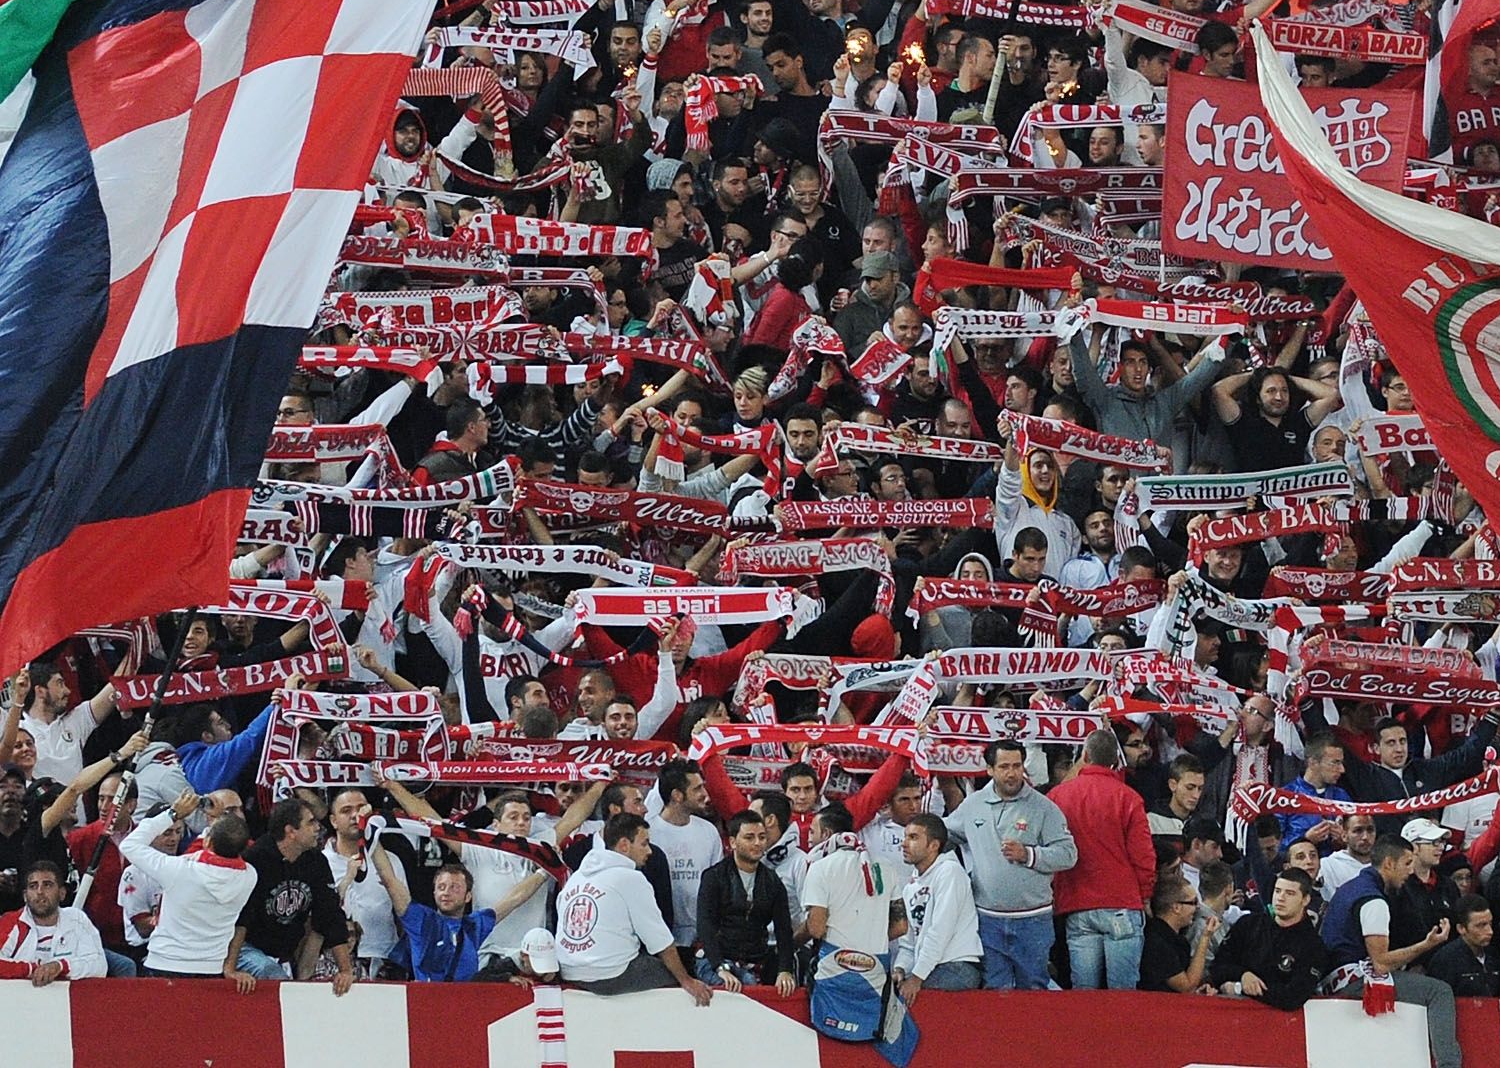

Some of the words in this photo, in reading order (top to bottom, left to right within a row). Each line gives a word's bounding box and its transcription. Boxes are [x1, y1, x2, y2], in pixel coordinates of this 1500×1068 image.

[1145, 18, 1164, 34] as
[1274, 22, 1345, 49] FORZA
[1370, 32, 1424, 56] BARI
[431, 292, 496, 323] Bari
[1142, 304, 1169, 321] as
[1174, 304, 1218, 325] bari
[478, 330, 524, 354] BARI
[611, 334, 693, 363] BARI
[1149, 480, 1247, 502] Stampo
[1255, 470, 1349, 493] Italiano
[803, 501, 871, 514] PASSIONE
[878, 502, 888, 513] E
[890, 500, 967, 515] ORGOGLIO
[827, 515, 842, 527] AL
[847, 515, 873, 527] TUO
[642, 597, 672, 614] as
[676, 594, 721, 613] bari
[480, 653, 530, 678] BARI
[939, 652, 1001, 677] BARI
[1005, 651, 1082, 675] SIAMO
[1328, 640, 1401, 663] FORZA
[1406, 646, 1468, 671] BARI
[126, 670, 212, 700] U.C.N.
[245, 649, 323, 687] BARI
[1304, 669, 1353, 690] Del
[1359, 672, 1417, 696] Bari
[442, 766, 473, 774] NON
[475, 765, 538, 774] MOLLATE
[540, 766, 567, 774] MAI
[1249, 784, 1300, 811] Noi
[675, 860, 685, 868] IS
[687, 859, 694, 868] A
